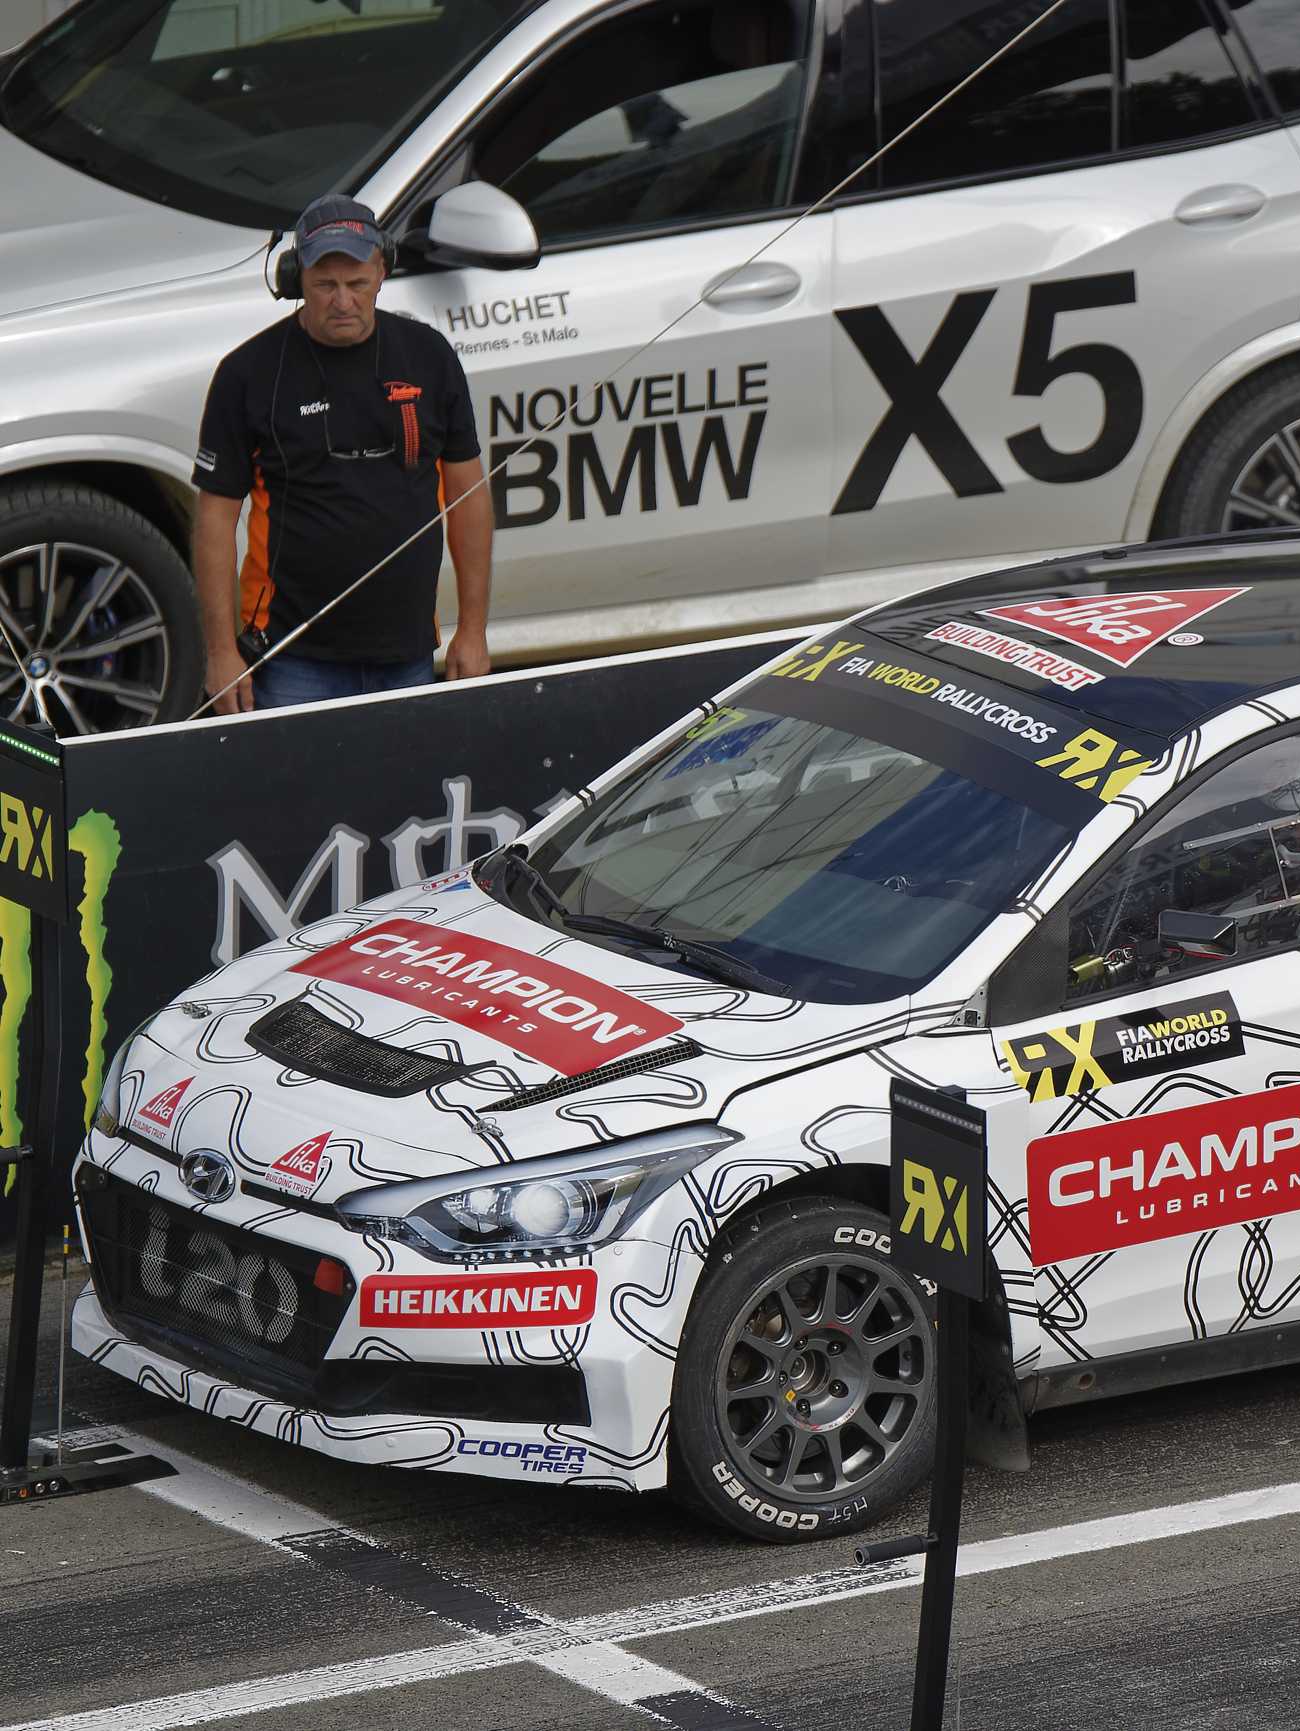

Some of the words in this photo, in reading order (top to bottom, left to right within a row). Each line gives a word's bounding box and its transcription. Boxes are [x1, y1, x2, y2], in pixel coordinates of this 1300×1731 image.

[446, 291, 570, 332] HUCHET
[454, 336, 509, 356] Rennes
[522, 331, 539, 346] St
[541, 326, 579, 342] Malo
[489, 361, 769, 437] NOUVELLE
[829, 269, 1145, 516] X5
[490, 409, 768, 530] BMW
[1024, 593, 1187, 646] Sika
[931, 623, 1026, 668] BUILDING
[1020, 649, 1097, 690] TRUST
[838, 655, 869, 677] FIA
[867, 661, 942, 696] WORLD
[930, 682, 1058, 745] RALLYCROSS
[350, 933, 640, 1044] CHAMPION
[361, 966, 538, 1033] LUBRICANTS
[1121, 1026, 1231, 1064] RALLYCROSS
[146, 1087, 174, 1120] Sika
[280, 1140, 321, 1175] Sika
[265, 1171, 293, 1190] BUILDING
[291, 1179, 314, 1196] TRUST
[373, 1284, 583, 1315] HEIKKINEN
[456, 1439, 588, 1463] COOPER
[519, 1459, 585, 1475] TIRES
[711, 1459, 820, 1530] COOPER
